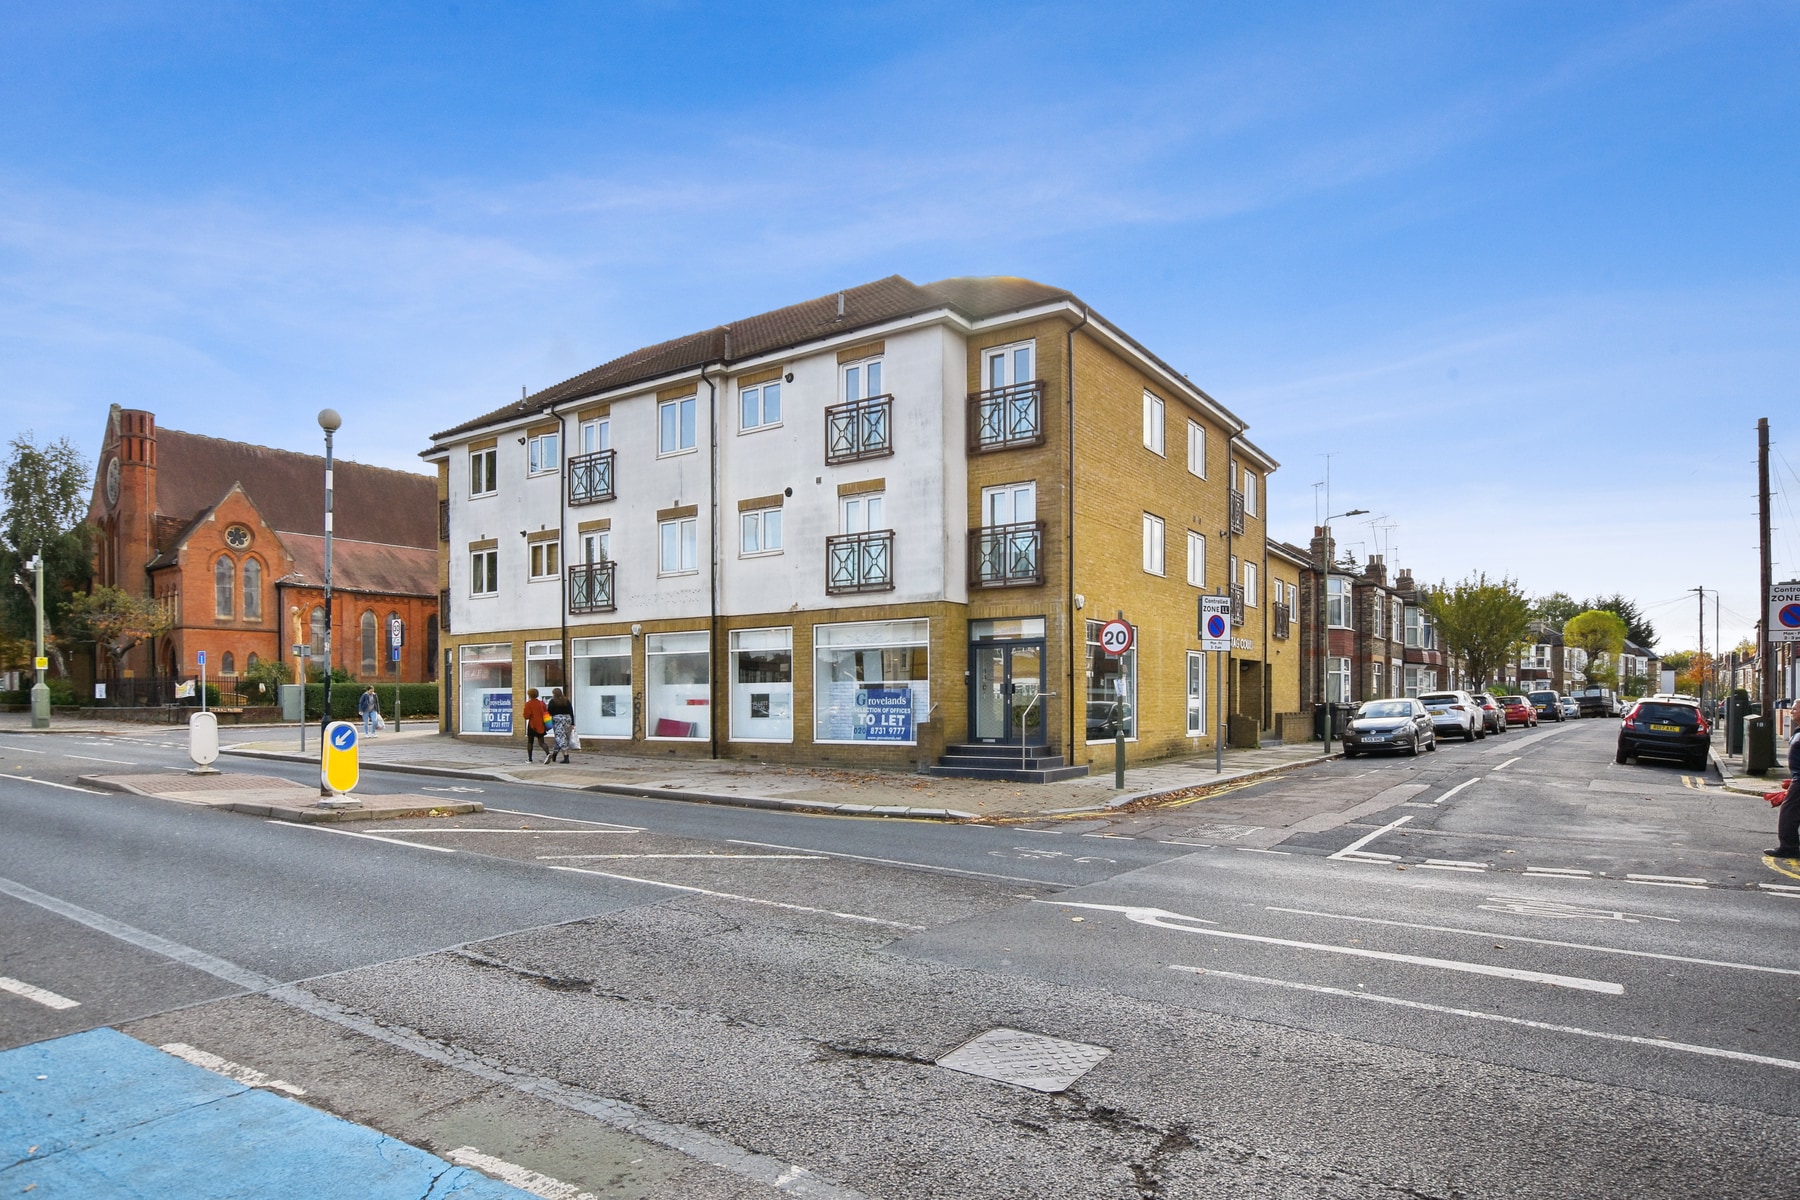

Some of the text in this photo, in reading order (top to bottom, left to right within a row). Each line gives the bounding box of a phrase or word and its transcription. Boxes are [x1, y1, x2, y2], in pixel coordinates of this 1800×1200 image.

[1771, 594, 1800, 602] ZONE
[1203, 605, 1220, 613] ZONE
[1104, 630, 1127, 645] 20
[856, 693, 907, 707] Grovelands
[485, 713, 510, 722] TO LET
[858, 713, 905, 727] TO LET
